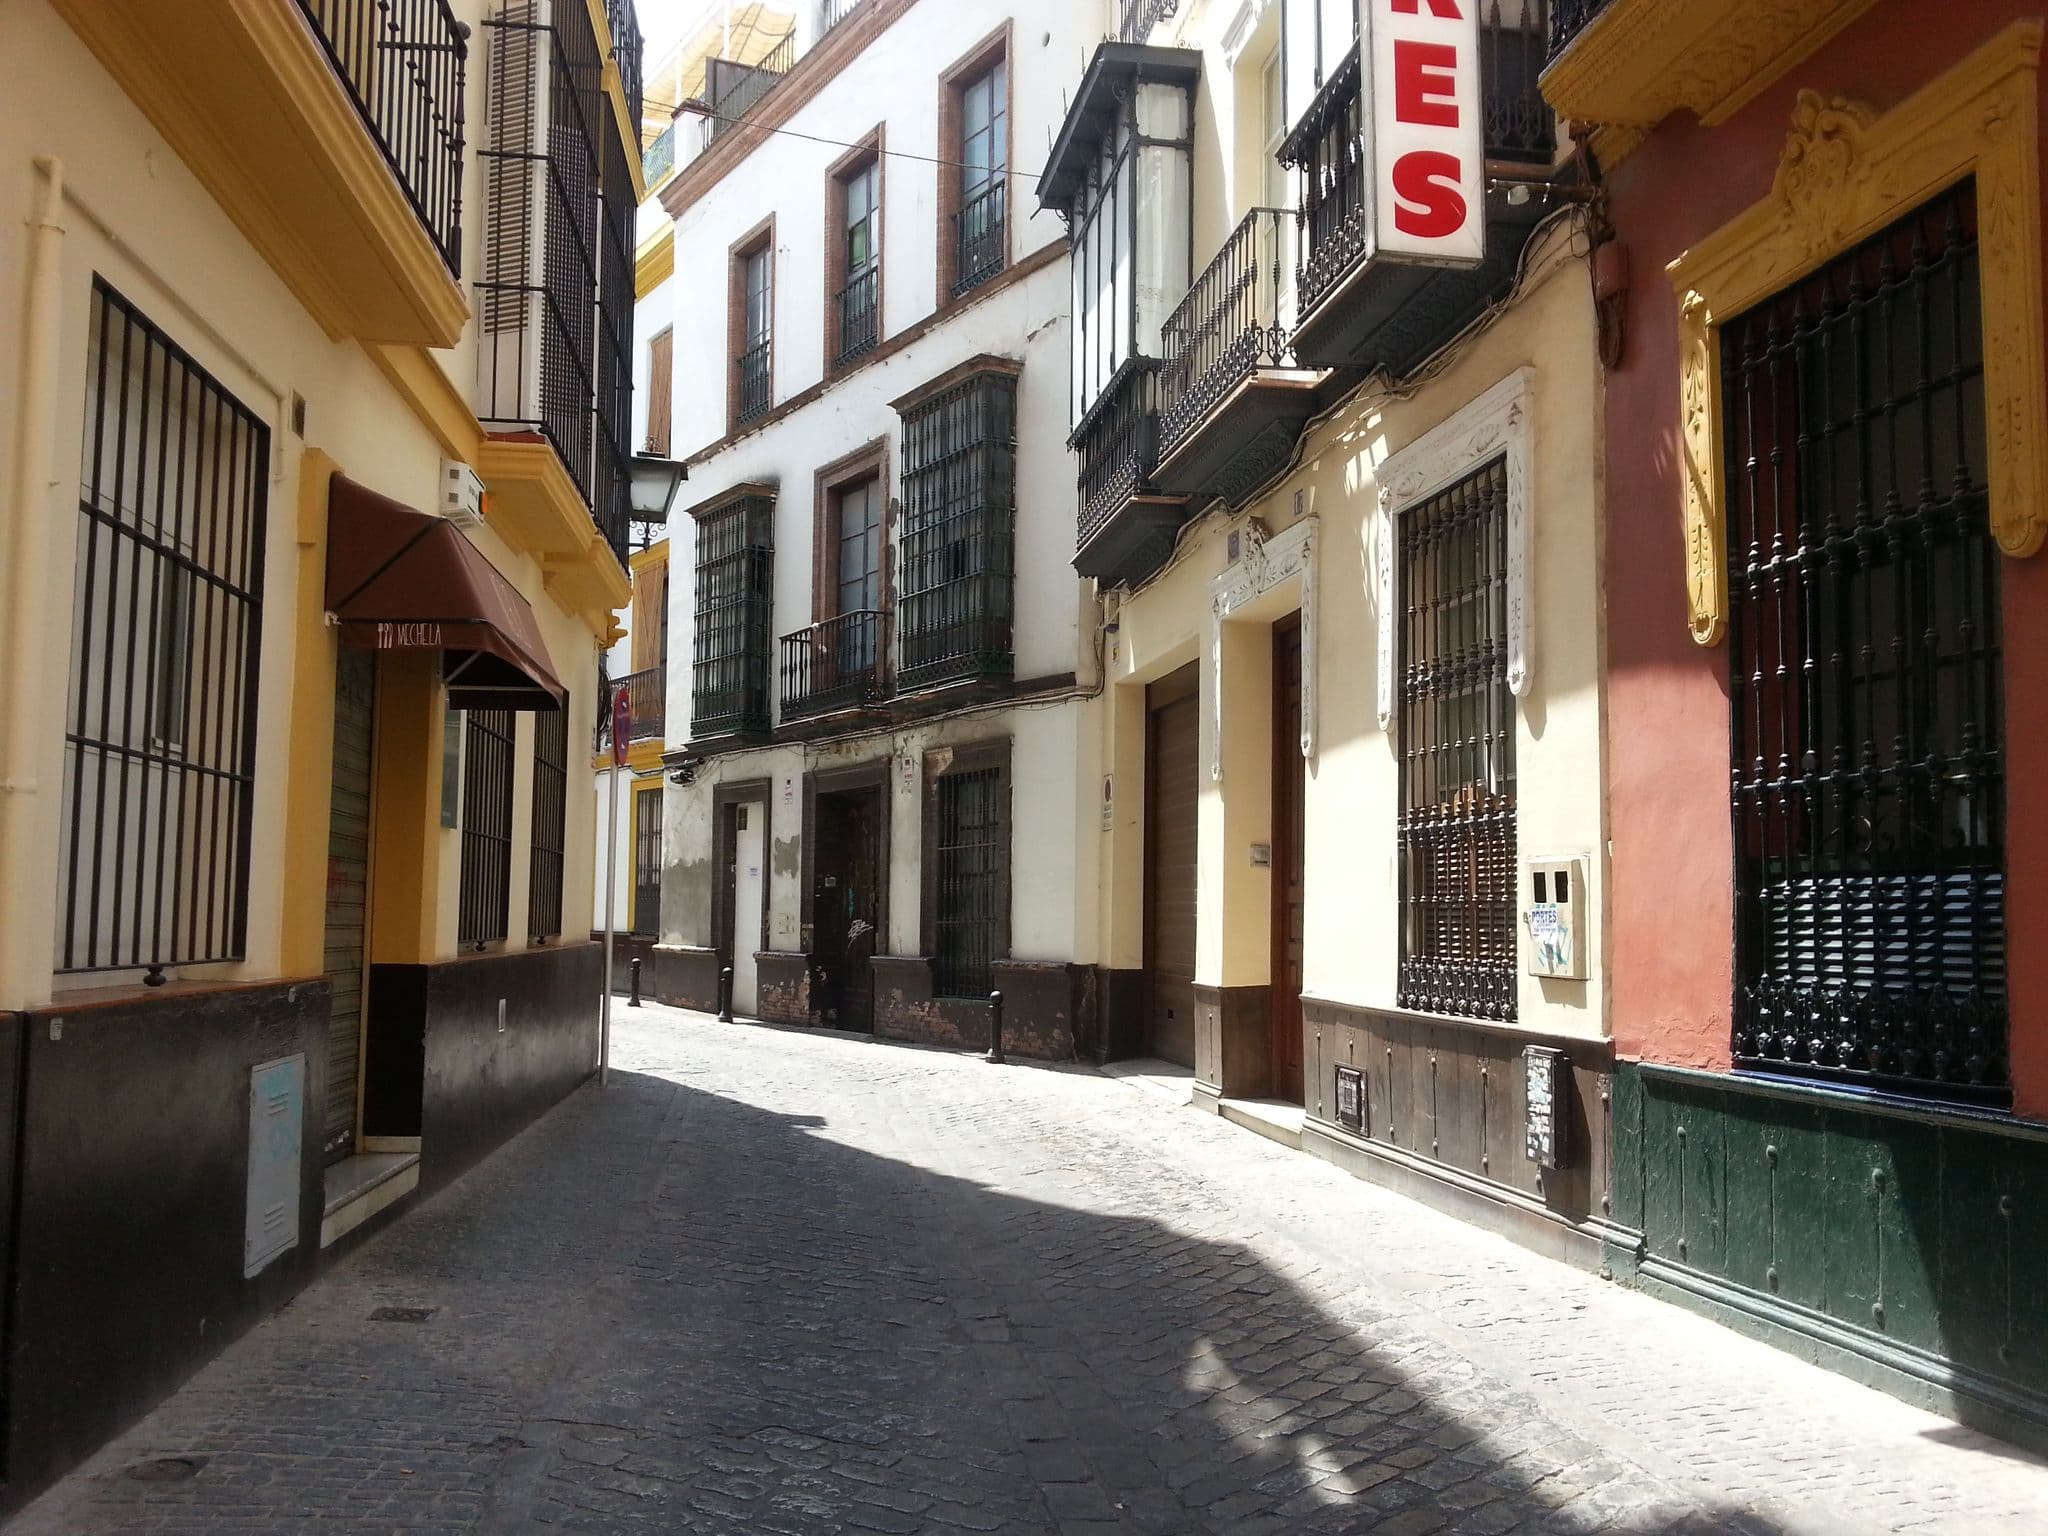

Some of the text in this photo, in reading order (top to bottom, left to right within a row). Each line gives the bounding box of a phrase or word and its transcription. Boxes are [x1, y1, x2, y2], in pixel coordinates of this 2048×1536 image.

[1391, 0, 1467, 238] ES
[397, 622, 442, 646] MECHELA
[1531, 909, 1557, 924] PORTES
